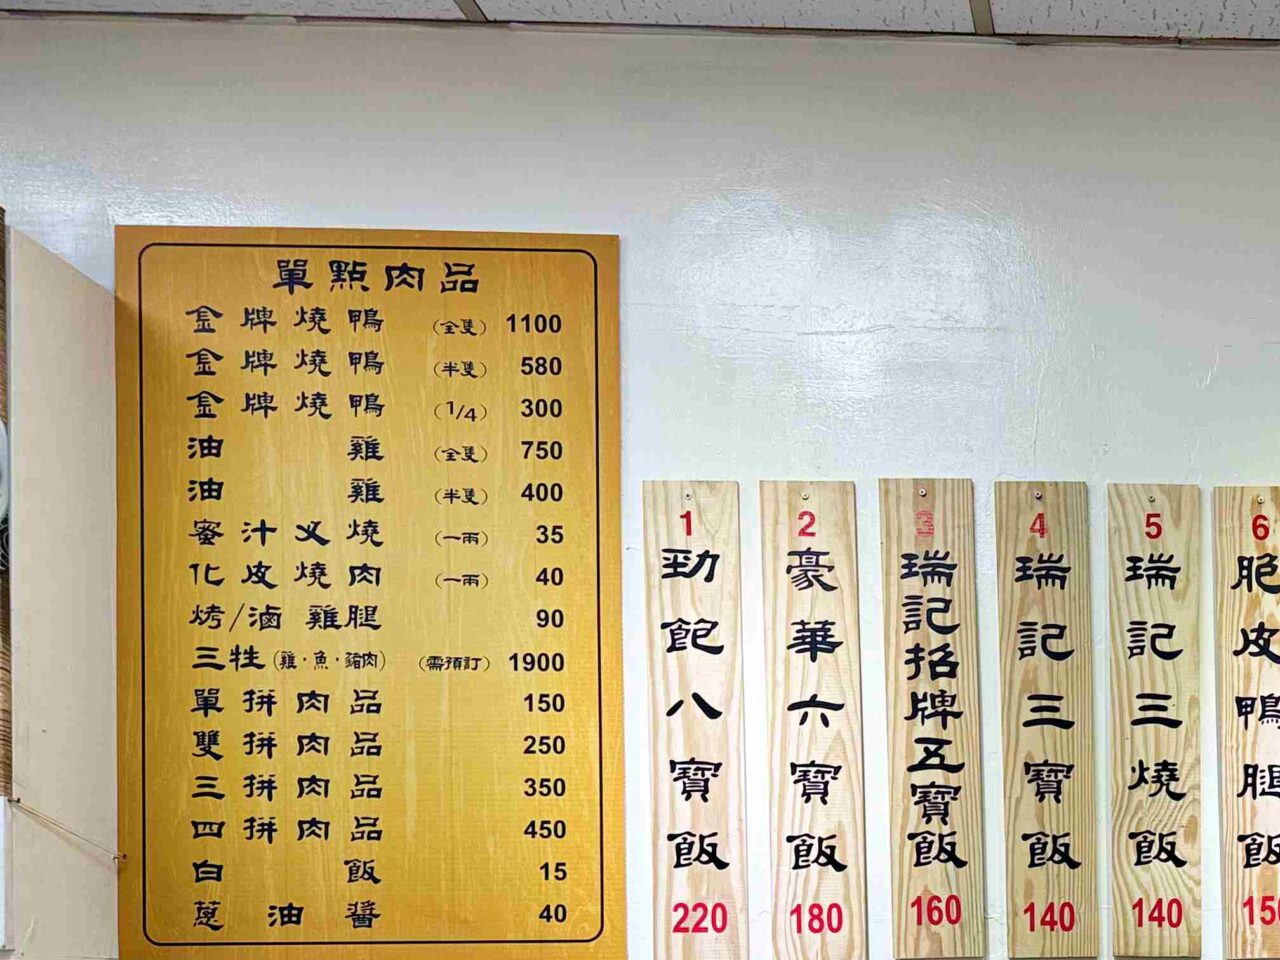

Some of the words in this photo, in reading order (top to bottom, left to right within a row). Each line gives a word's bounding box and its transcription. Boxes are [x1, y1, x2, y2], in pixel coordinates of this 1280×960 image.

[272, 258, 480, 296] 單點肉品
[185, 305, 384, 335] 金牌燒鴨
[506, 313, 562, 334] 1100
[185, 347, 385, 378] 金牌燒鴨
[520, 356, 562, 376] 580
[186, 390, 385, 420] 金牌燒鴨
[520, 398, 563, 418] 300
[521, 440, 563, 460] 750
[520, 482, 563, 502] 400
[536, 524, 564, 544] 35
[681, 511, 693, 537] 1
[797, 510, 817, 538] 2
[1145, 513, 1163, 541] 5
[1250, 513, 1270, 543] 6
[188, 560, 382, 590] 化皮燒肉
[535, 567, 564, 586] 40
[536, 609, 564, 628] 90
[509, 652, 565, 672] 1900
[190, 687, 382, 718] 單拼肉品
[524, 693, 565, 713] 150
[785, 547, 848, 873] 豪華六寶飯
[900, 549, 968, 869] 瑞記招牌五寶飯
[1014, 552, 1082, 870] 瑞記三寶飯
[1124, 552, 1188, 868] 瑞記三燒飯
[191, 729, 383, 762] 雙拼肉品
[523, 735, 566, 755] 250
[191, 773, 383, 802] 三拼肉品
[524, 777, 566, 797] 350
[190, 816, 383, 845] 四拼肉品
[523, 820, 566, 839] 450
[540, 862, 567, 881] 15
[538, 904, 567, 923] 40
[671, 900, 730, 935] 220
[789, 901, 844, 935] 180
[909, 893, 963, 927] 160
[1023, 900, 1077, 933] 140
[1131, 896, 1184, 929] 140
